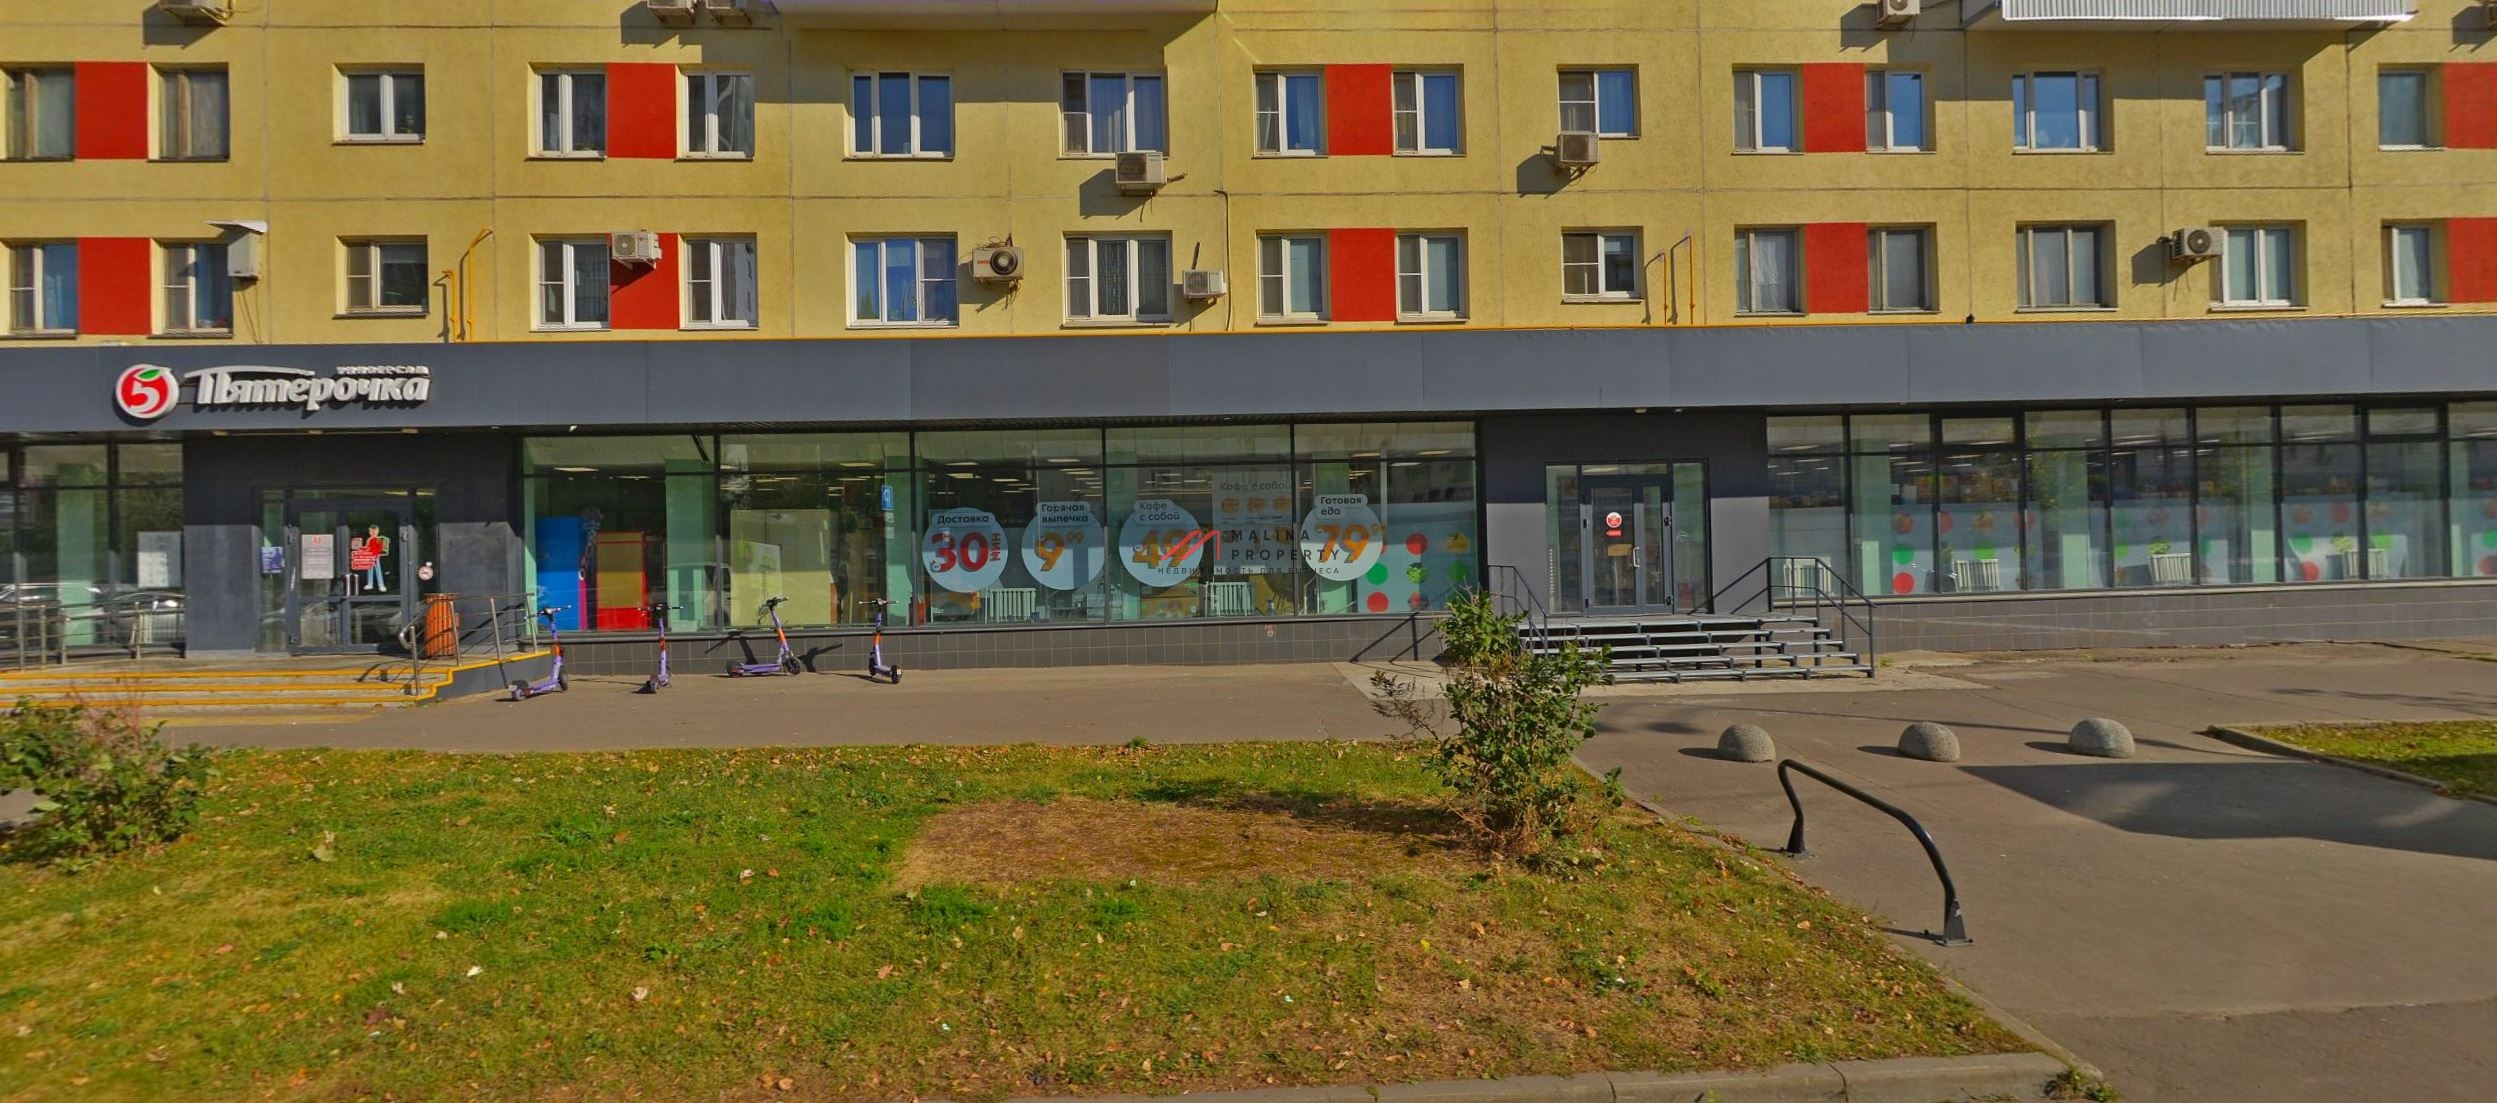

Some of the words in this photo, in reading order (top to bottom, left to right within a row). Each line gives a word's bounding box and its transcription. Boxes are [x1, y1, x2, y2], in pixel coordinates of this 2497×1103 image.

[184, 365, 430, 411] Пятерочка
[1320, 496, 1362, 505] Готовая
[1041, 503, 1085, 513] Горячая
[1139, 502, 1168, 512] Кофе
[1320, 506, 1341, 516] еда
[937, 515, 990, 525] Доставка
[1041, 514, 1089, 523] выпечка
[1148, 511, 1181, 521] собой
[1314, 523, 1370, 563] 79
[930, 531, 989, 573] 30
[1132, 529, 1191, 569] 49
